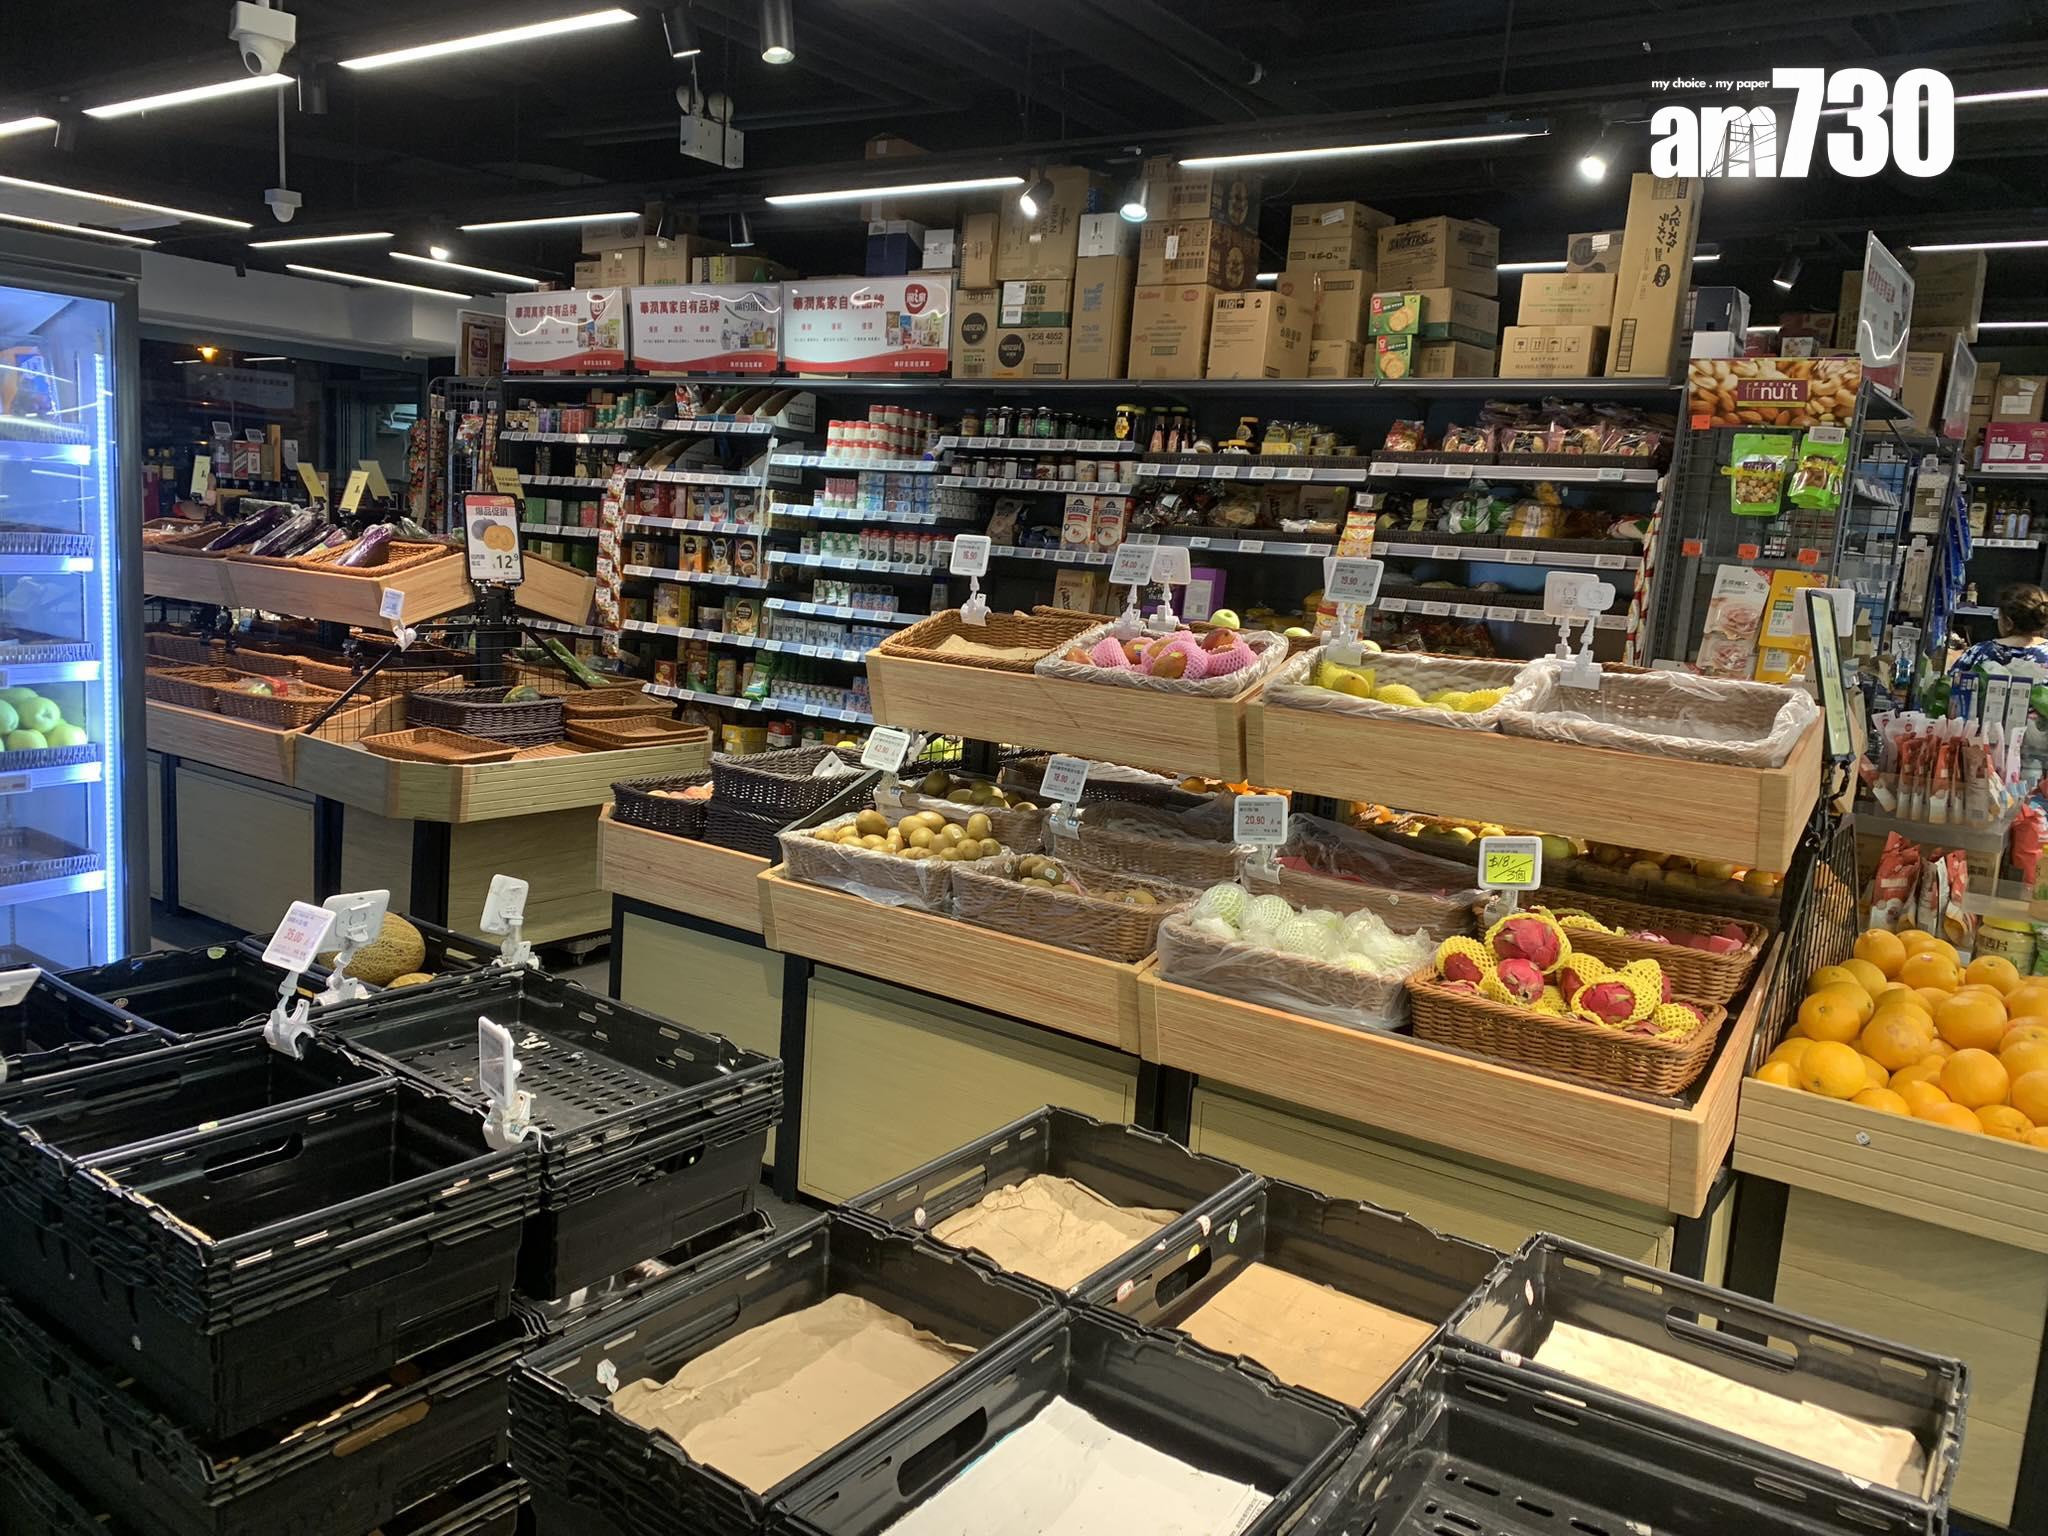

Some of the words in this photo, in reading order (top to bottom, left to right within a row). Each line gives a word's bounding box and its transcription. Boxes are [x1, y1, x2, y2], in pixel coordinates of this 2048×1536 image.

[639, 299, 720, 316] 華潤萬家自有品牌
